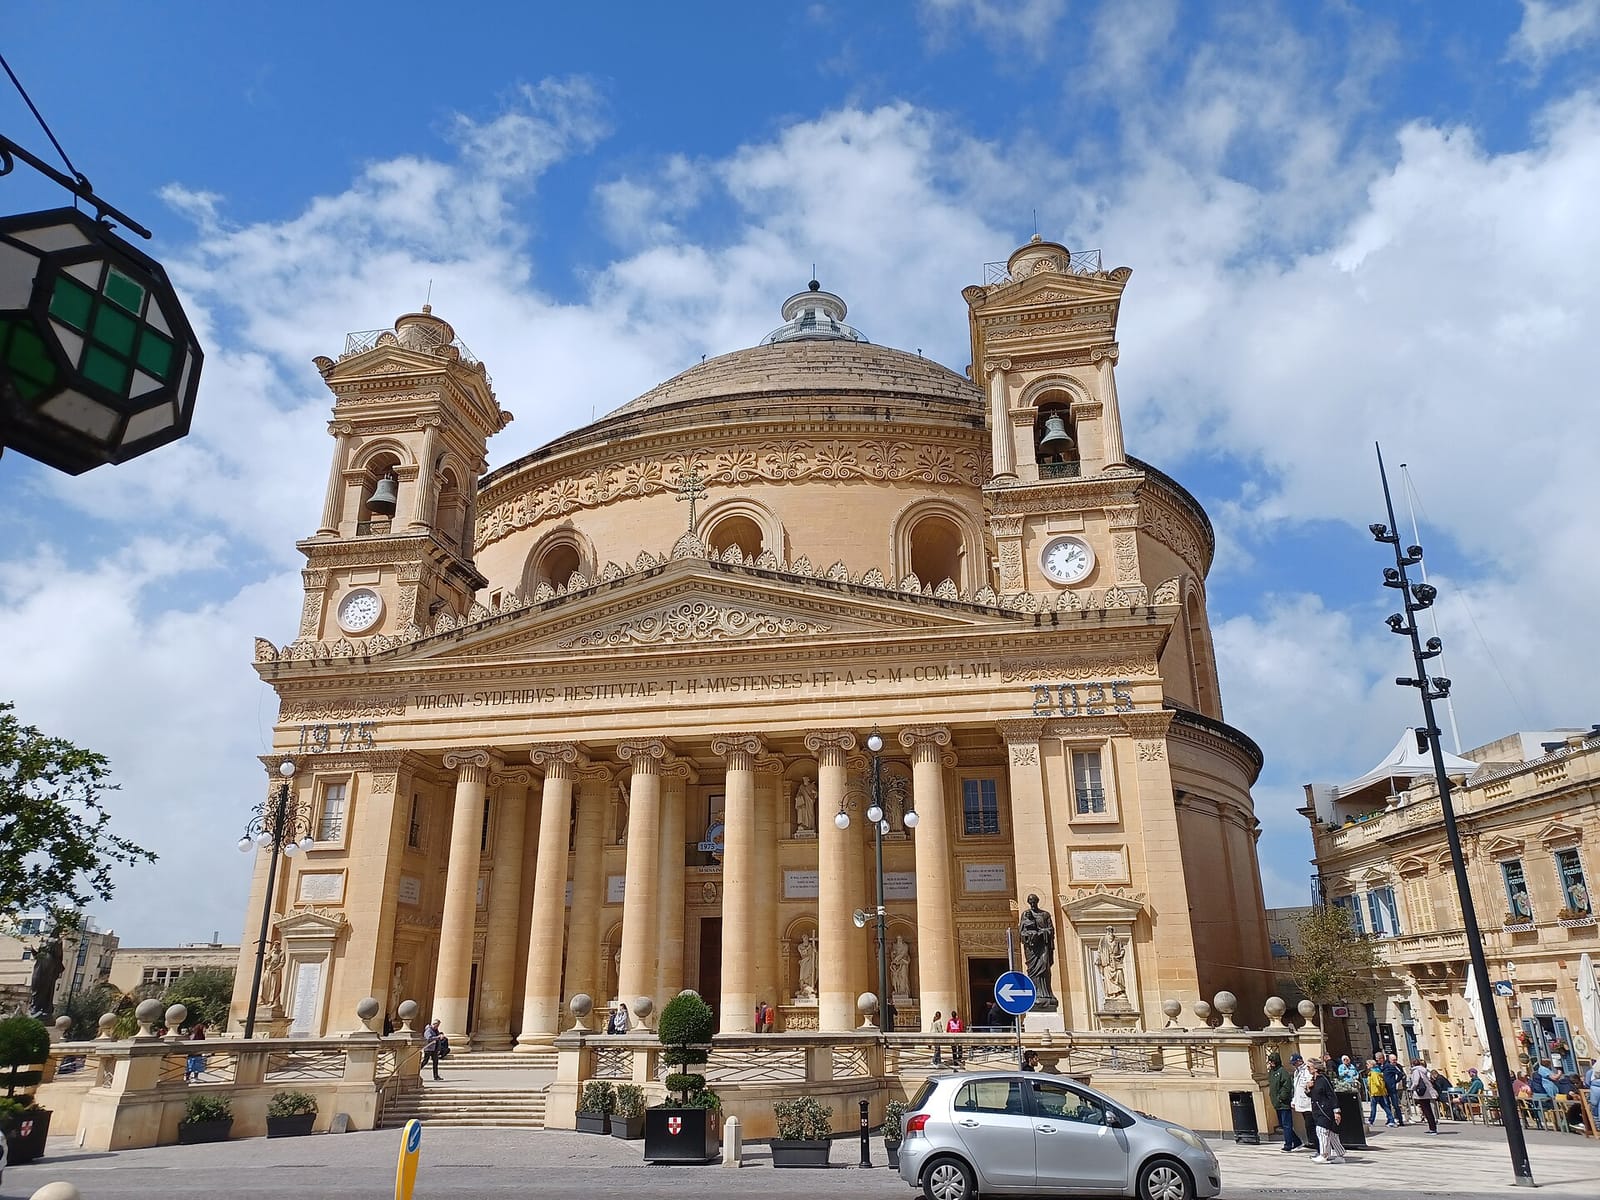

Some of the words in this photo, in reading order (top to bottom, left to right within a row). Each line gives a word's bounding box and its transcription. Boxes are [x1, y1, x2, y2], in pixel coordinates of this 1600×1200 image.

[415, 693, 464, 710] VIRGINI
[473, 687, 555, 706] SYDERIBVS
[564, 681, 658, 701] RESTITVTAE
[707, 673, 802, 693] MVSTENSES
[1030, 680, 1133, 717] 2025
[298, 721, 375, 753] 1975
[700, 842, 716, 850] 1975
